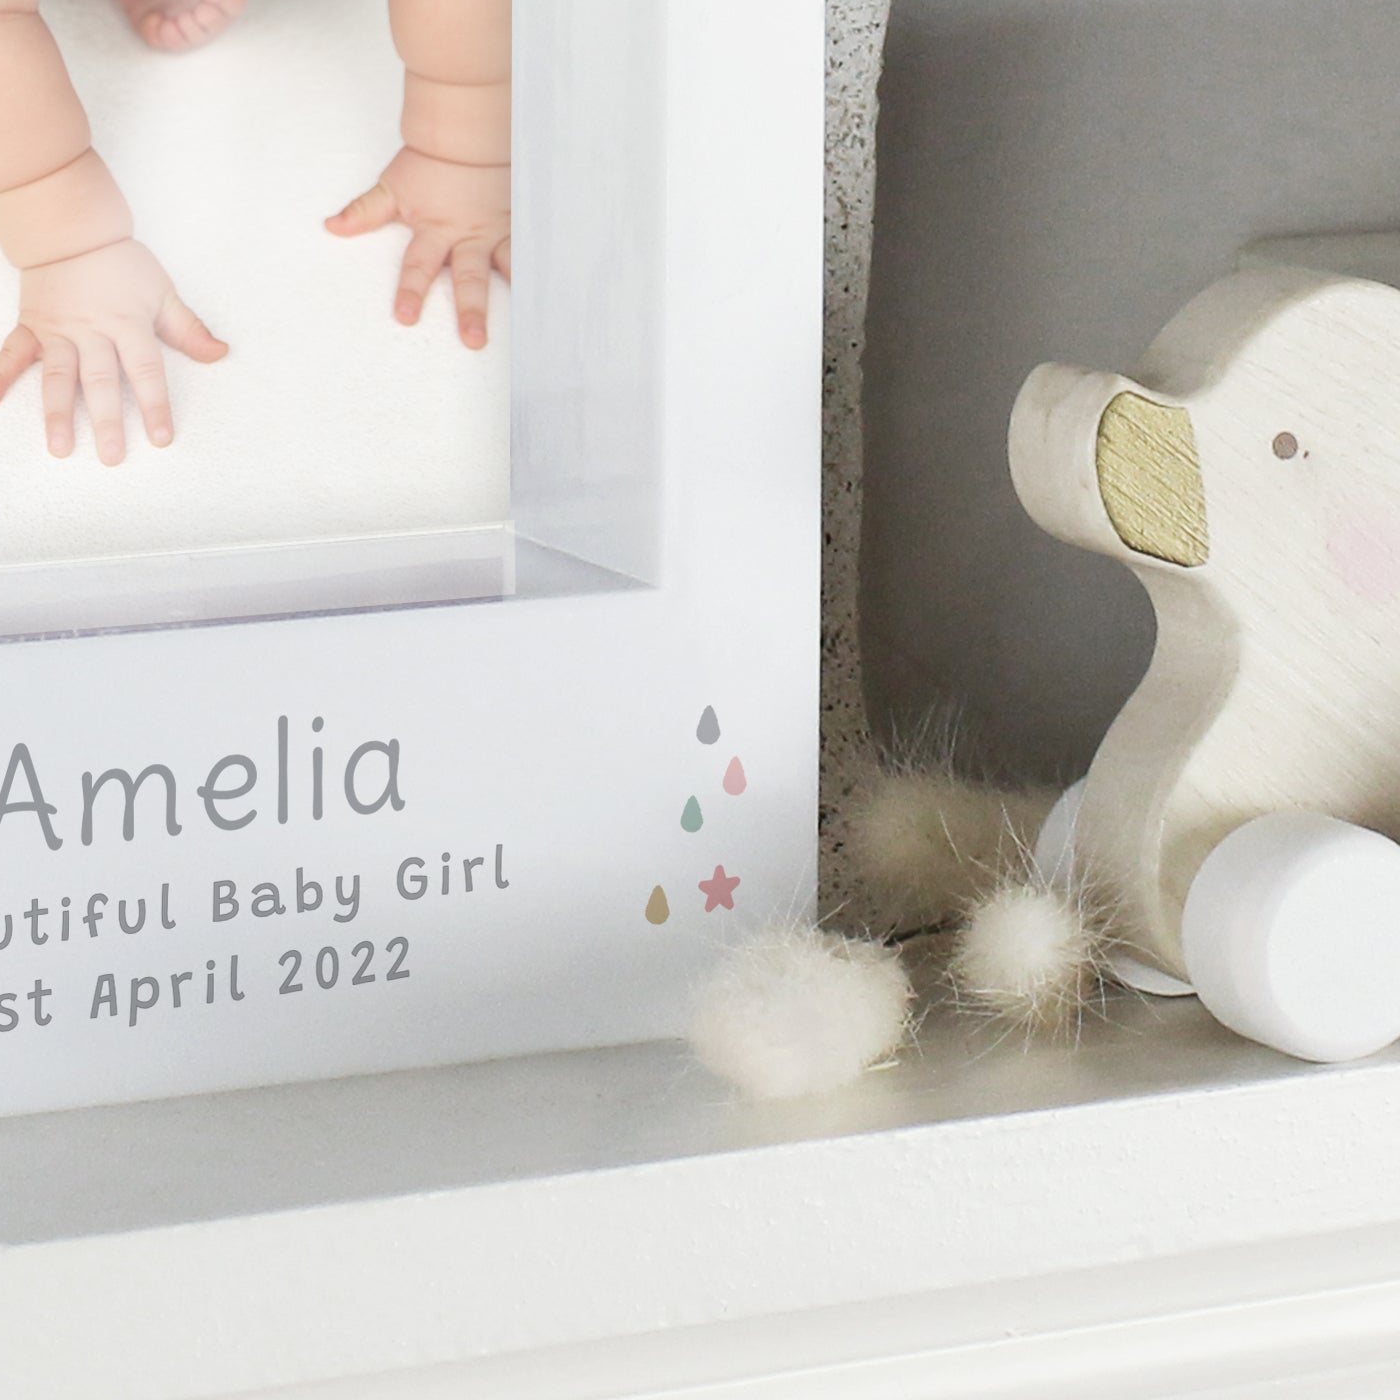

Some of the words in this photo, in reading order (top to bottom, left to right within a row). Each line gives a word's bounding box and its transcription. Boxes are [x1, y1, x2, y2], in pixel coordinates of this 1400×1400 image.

[212, 866, 361, 924] Baby
[396, 843, 510, 901] Girl
[89, 954, 246, 1028] April
[277, 936, 411, 995] 2022
